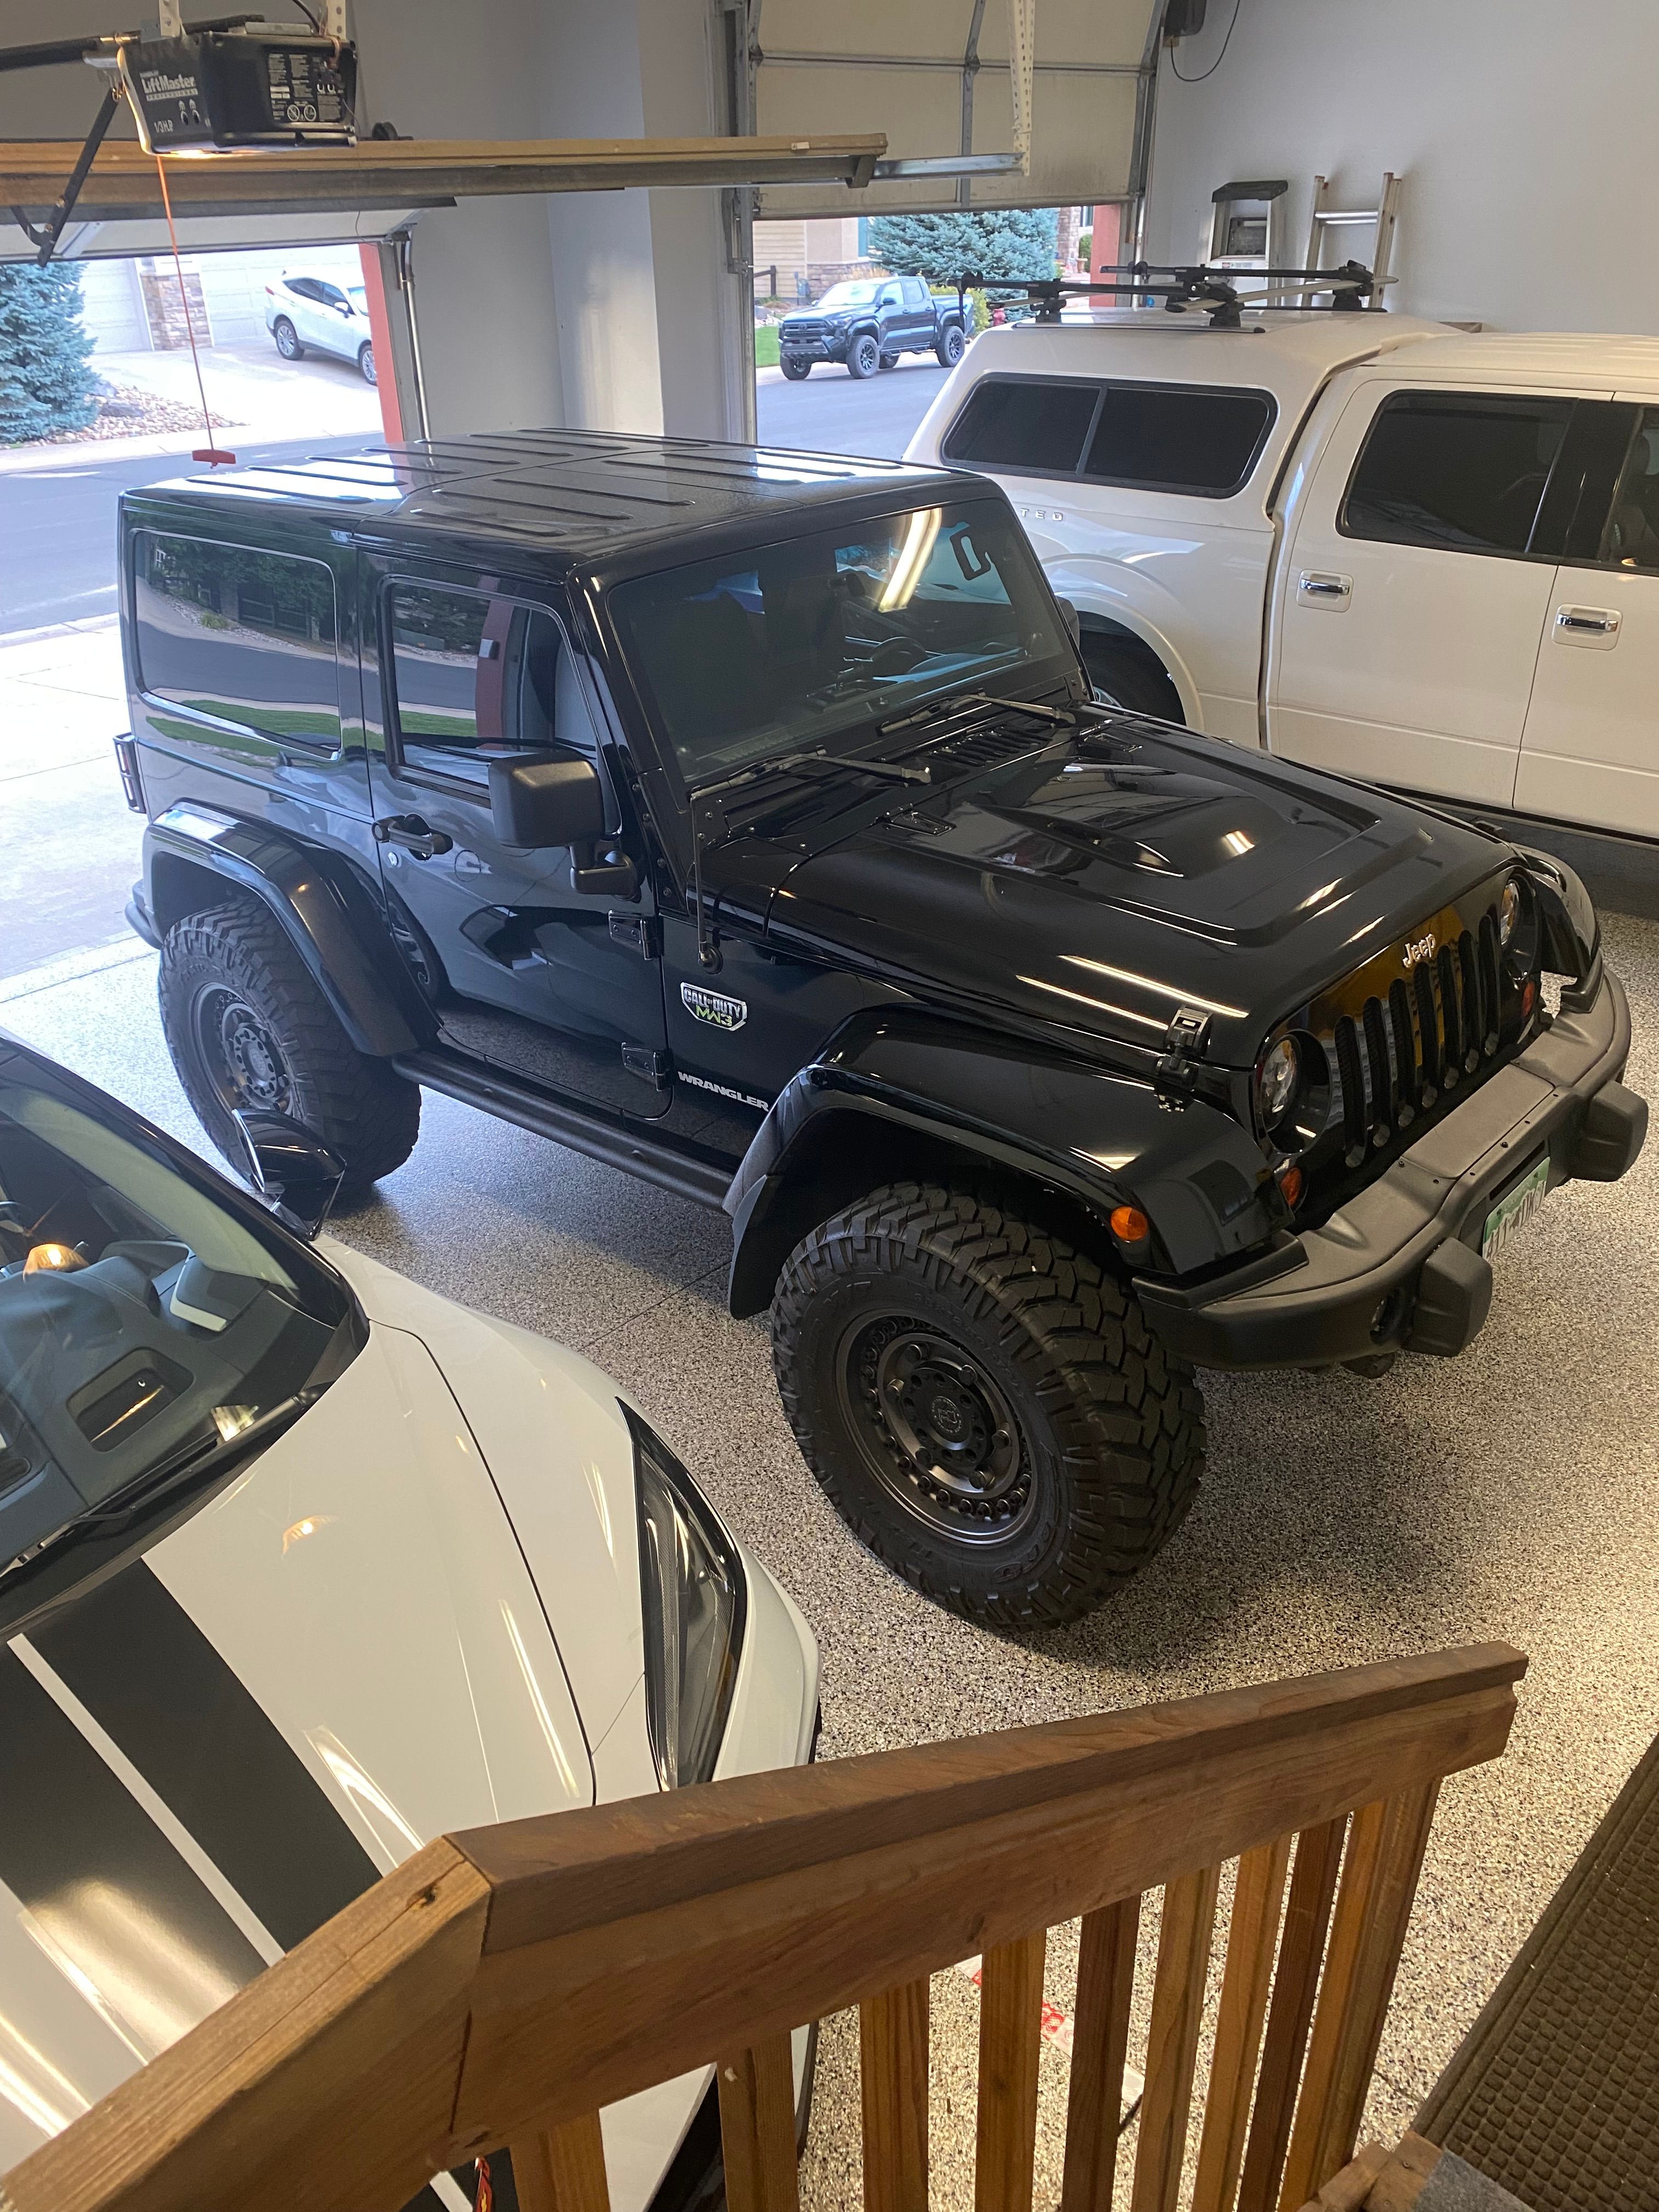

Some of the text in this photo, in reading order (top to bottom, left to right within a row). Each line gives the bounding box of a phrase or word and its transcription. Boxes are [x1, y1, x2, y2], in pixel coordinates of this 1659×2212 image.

[141, 73, 196, 93] LiftMaster
[1402, 933, 1436, 968] Jeep
[684, 988, 709, 1008] CALL
[713, 997, 741, 1018] DUTY
[696, 1005, 732, 1026] MW3
[678, 1071, 769, 1112] WRANGLER
